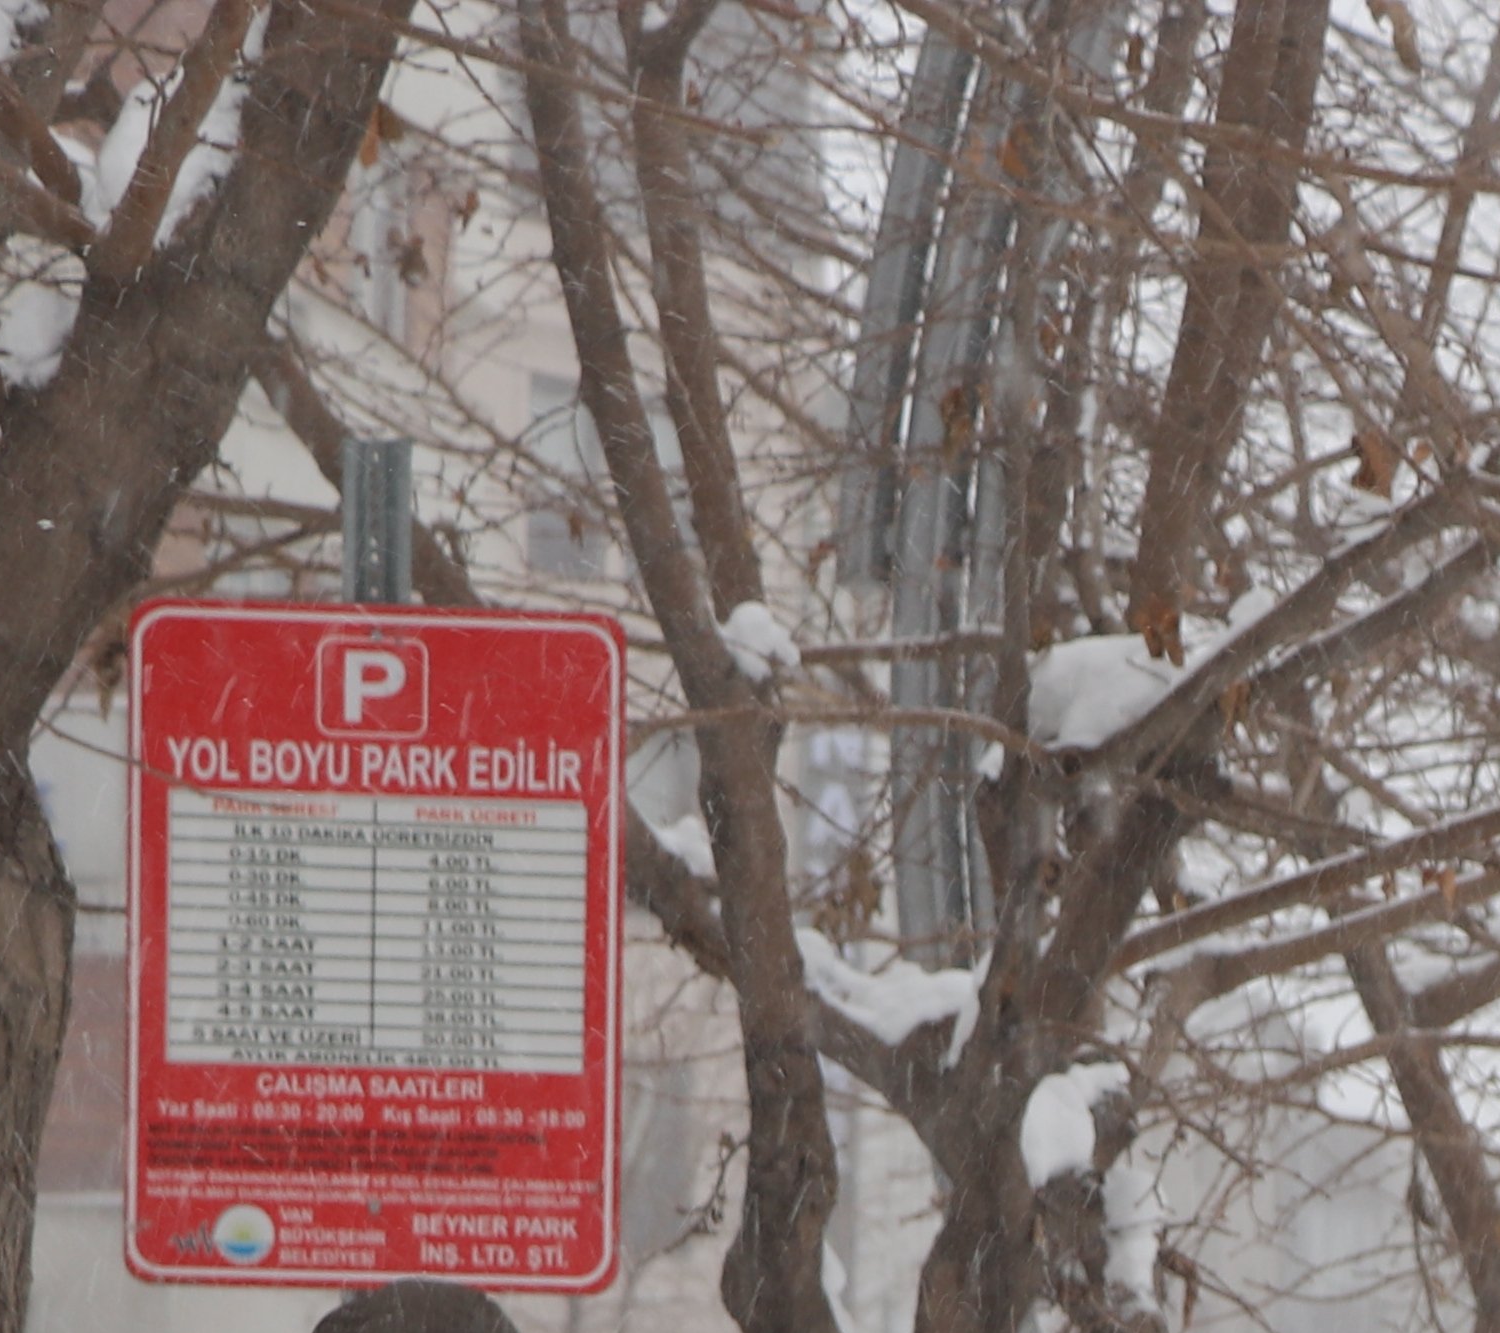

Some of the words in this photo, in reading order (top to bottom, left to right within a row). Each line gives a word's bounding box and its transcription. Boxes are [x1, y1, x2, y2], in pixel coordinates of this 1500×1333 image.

[168, 737, 241, 782] YOL
[249, 740, 351, 786] BOYU
[362, 743, 457, 789] PARK
[468, 738, 582, 792] EDİLİR
[256, 1072, 365, 1101] ÇALIŞMA
[369, 1074, 485, 1102] SAATLERİ
[412, 1211, 510, 1238] BEYNER
[513, 1214, 581, 1241] PARK
